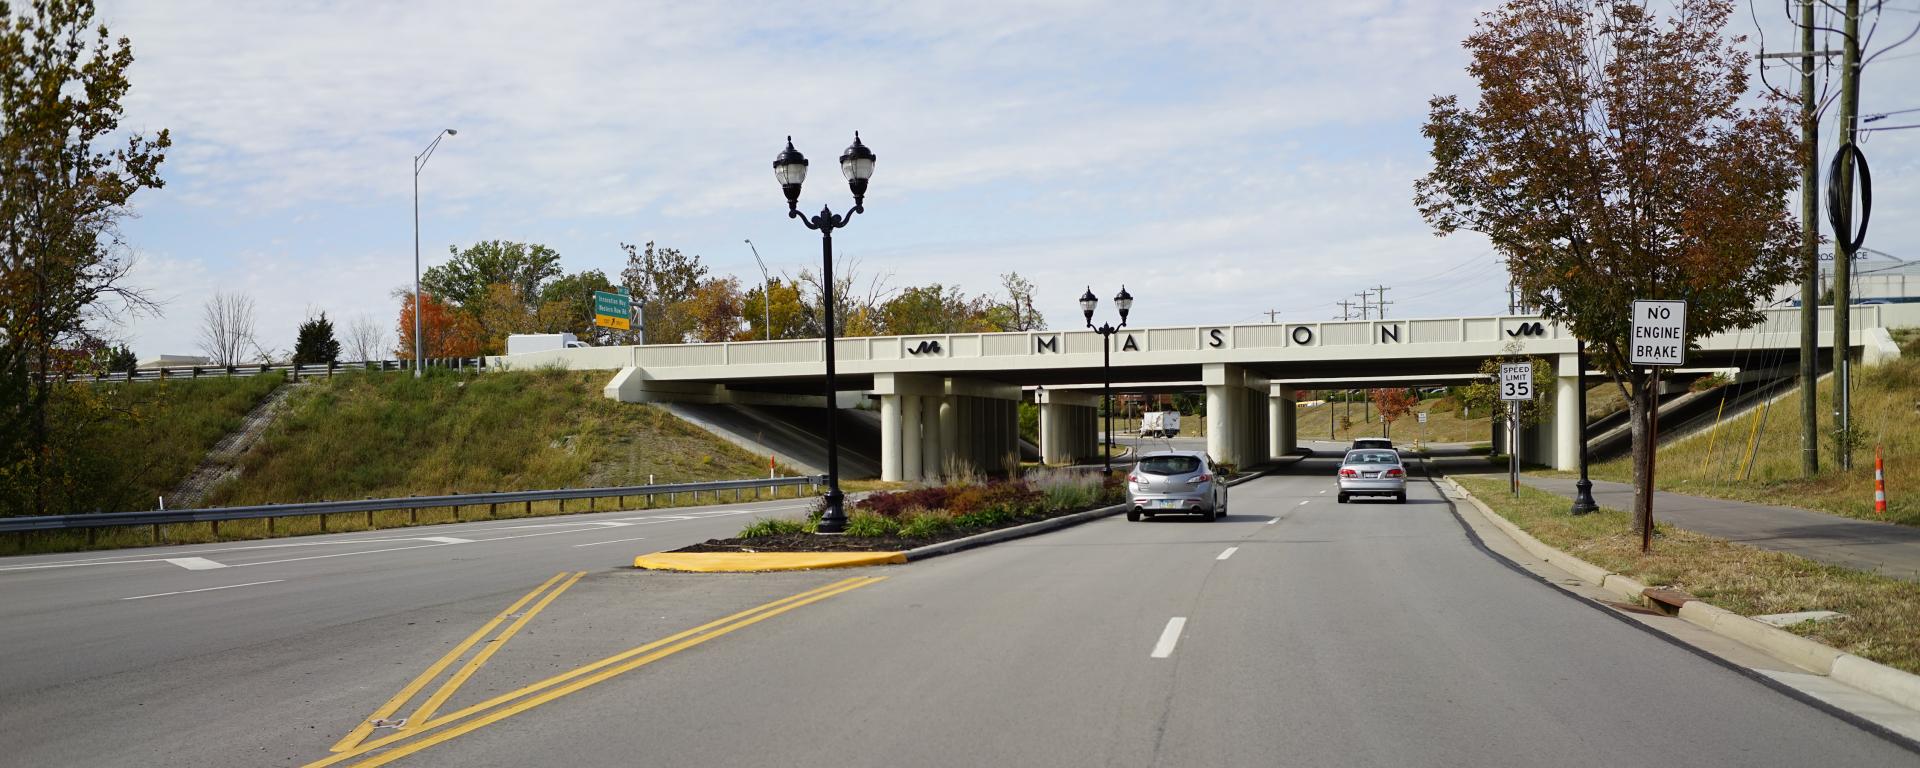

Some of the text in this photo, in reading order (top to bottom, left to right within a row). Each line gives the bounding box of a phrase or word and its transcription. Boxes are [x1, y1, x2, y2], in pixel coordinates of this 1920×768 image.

[1648, 307, 1670, 319] NO
[1636, 326, 1680, 339] ENGINE
[1637, 345, 1677, 358] BRAKE
[1505, 382, 1528, 396] 35
